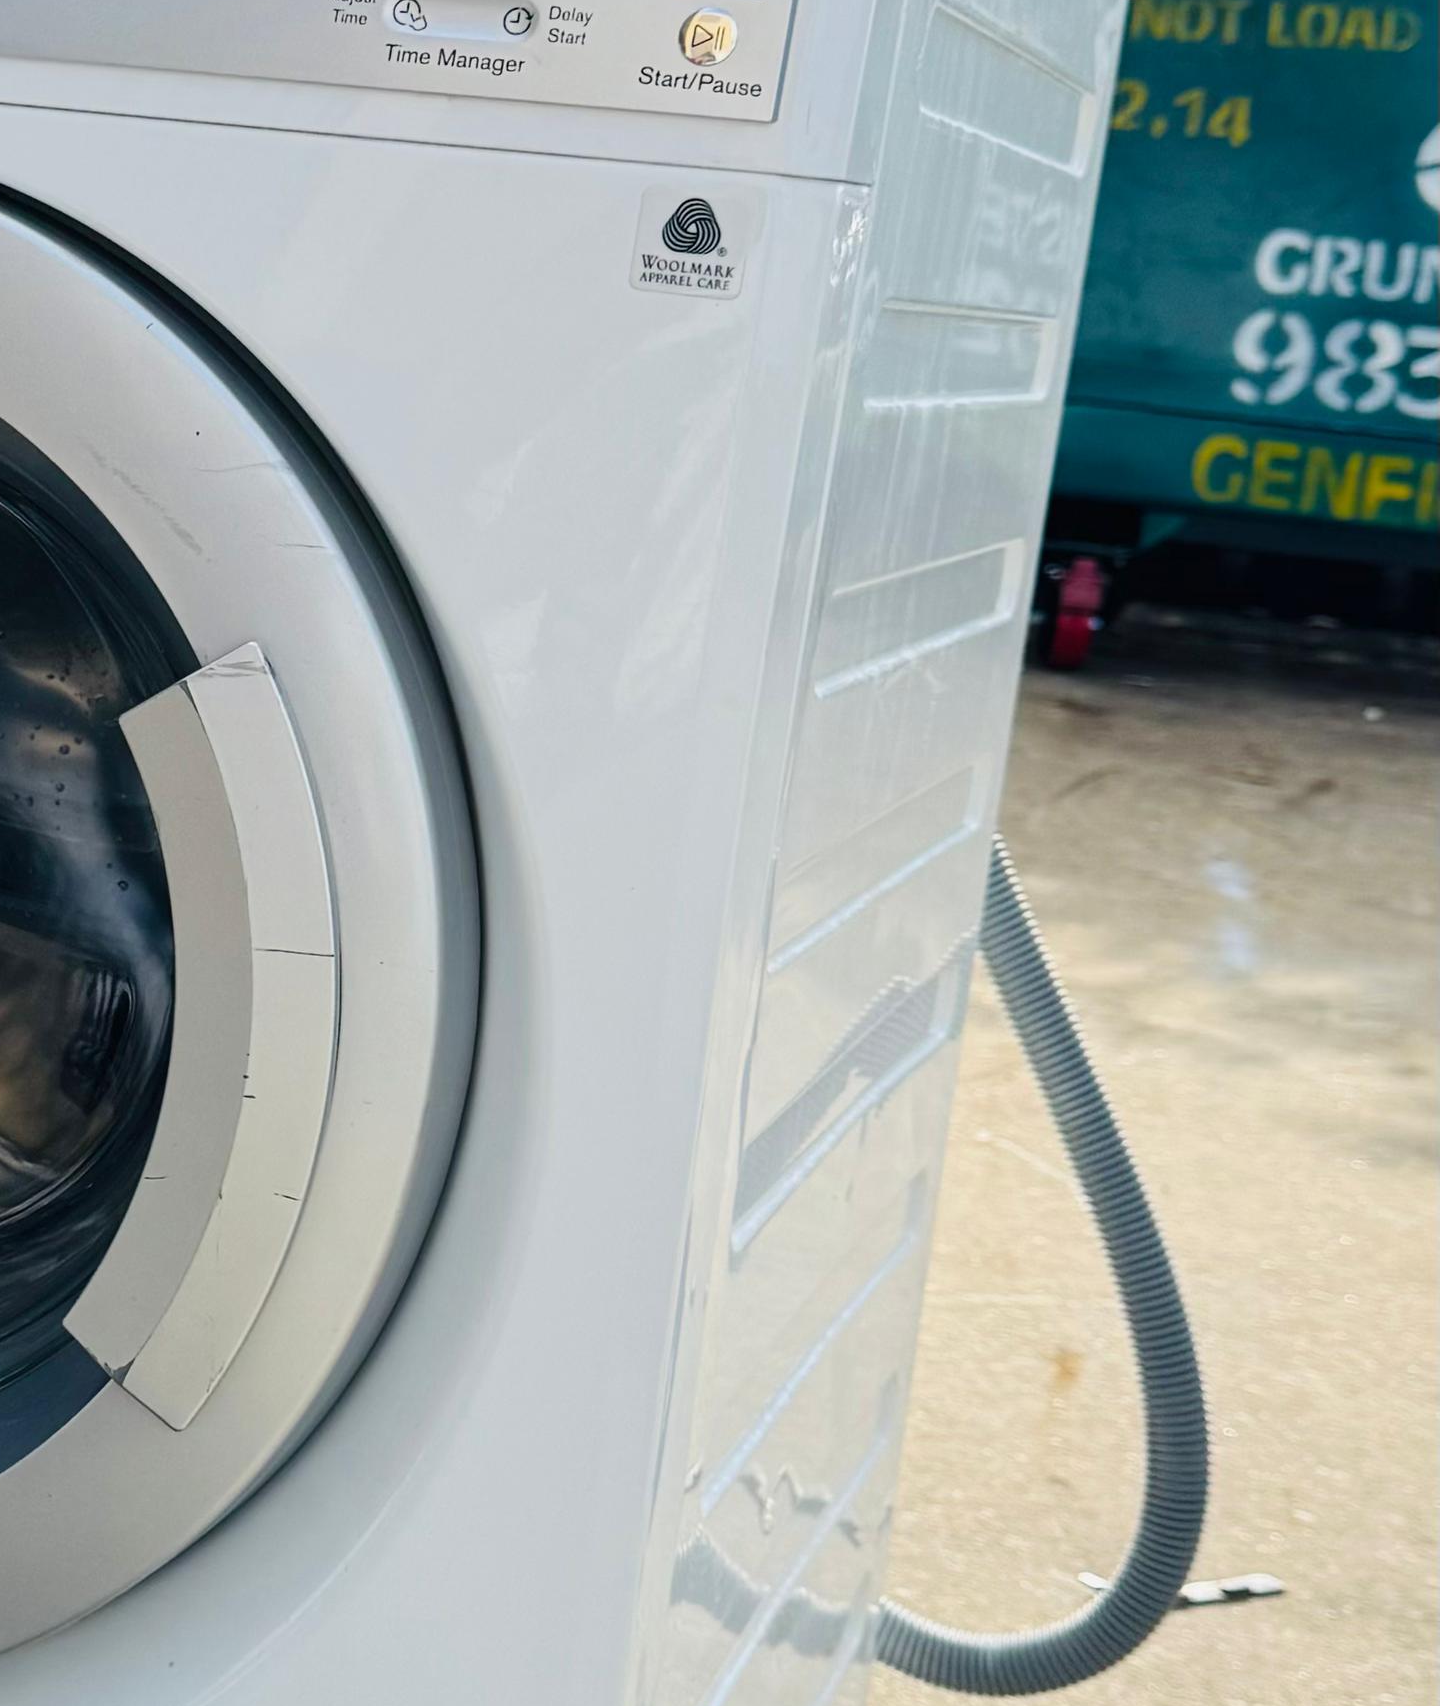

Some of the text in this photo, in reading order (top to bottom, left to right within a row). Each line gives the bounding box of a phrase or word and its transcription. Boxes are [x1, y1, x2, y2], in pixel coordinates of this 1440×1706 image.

[332, 9, 367, 26] Time
[548, 5, 594, 27] Delay
[1266, 0, 1421, 52] LOAD
[547, 29, 586, 46] Start
[385, 44, 525, 75] Time Manager
[638, 66, 762, 97] Start/Pause
[641, 253, 735, 278] WOOLMARK
[639, 271, 730, 291] APPAREL CARE
